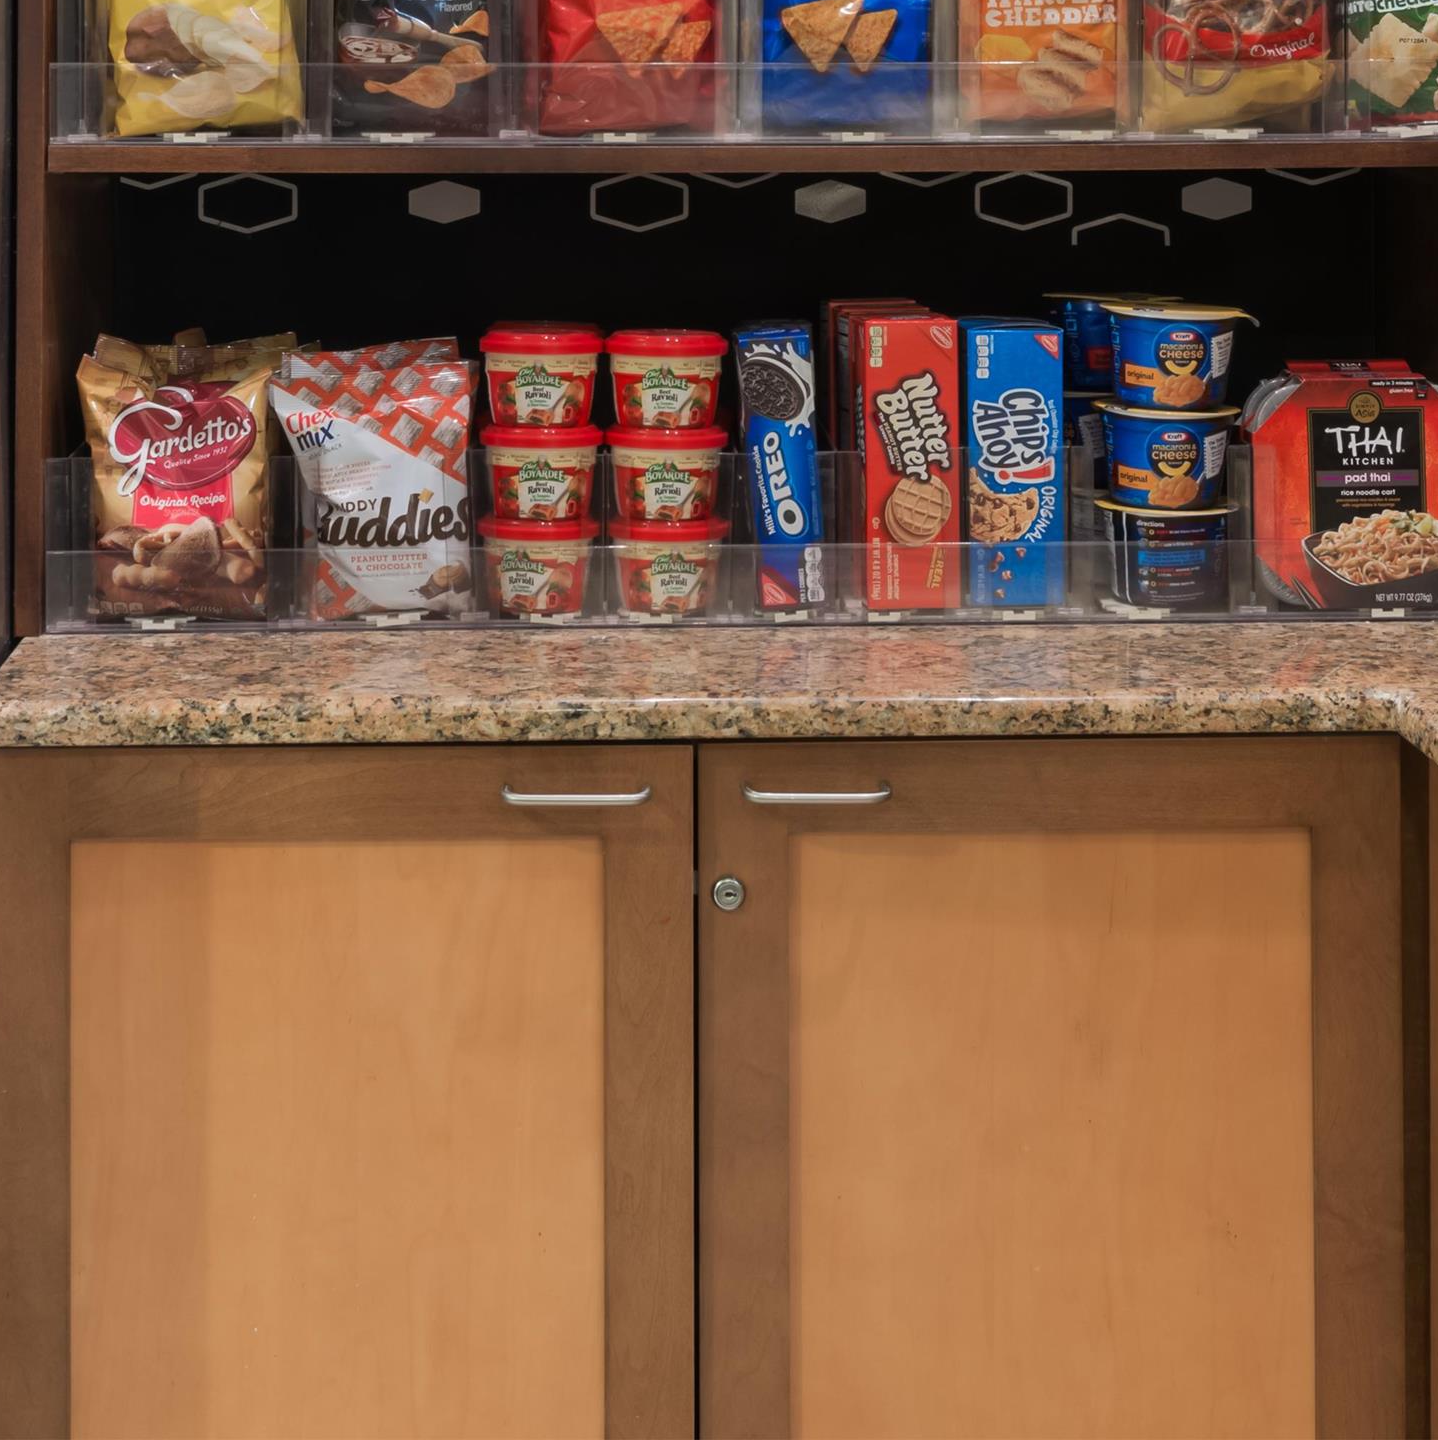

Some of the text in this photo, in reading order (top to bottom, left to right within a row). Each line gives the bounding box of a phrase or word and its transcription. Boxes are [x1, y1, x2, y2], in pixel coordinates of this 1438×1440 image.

[438, 1, 473, 12] Flavored
[985, 4, 1118, 28] CHEDDAR
[1249, 32, 1316, 60] Original
[1173, 332, 1193, 341] Kraft
[1160, 343, 1198, 354] macaroni
[515, 374, 562, 388] BOYARDEE
[1126, 370, 1155, 382] original
[642, 376, 689, 389] BOYARDEE
[524, 390, 552, 401] Ravioli
[650, 392, 679, 403] Ravioli
[285, 406, 337, 435] Chex
[902, 372, 950, 468] Nutter
[876, 388, 929, 481] Butter
[1165, 432, 1184, 441] Kraft
[1324, 425, 1404, 457] THAI
[1152, 444, 1191, 454] macaroni
[1342, 457, 1394, 466] KITCHEN
[518, 469, 565, 482] BOYARDEE
[644, 471, 691, 483] BOYARDEE
[1119, 472, 1148, 484] original
[1344, 472, 1391, 485] pad thai
[527, 484, 556, 495] Ravioli
[763, 431, 804, 536] OREO
[654, 486, 682, 497] Ravioli
[140, 492, 228, 510] Original Recipe
[1025, 486, 1058, 544] ORIGINAL
[1136, 520, 1165, 528] directions
[351, 553, 429, 563] PEANUT BUTTER
[366, 562, 424, 572] CHOCOLATE
[500, 561, 545, 574] BOYARDEE
[651, 562, 698, 574] BOYARDEE
[508, 576, 535, 586] Ravioli
[660, 577, 688, 587] Ravioli
